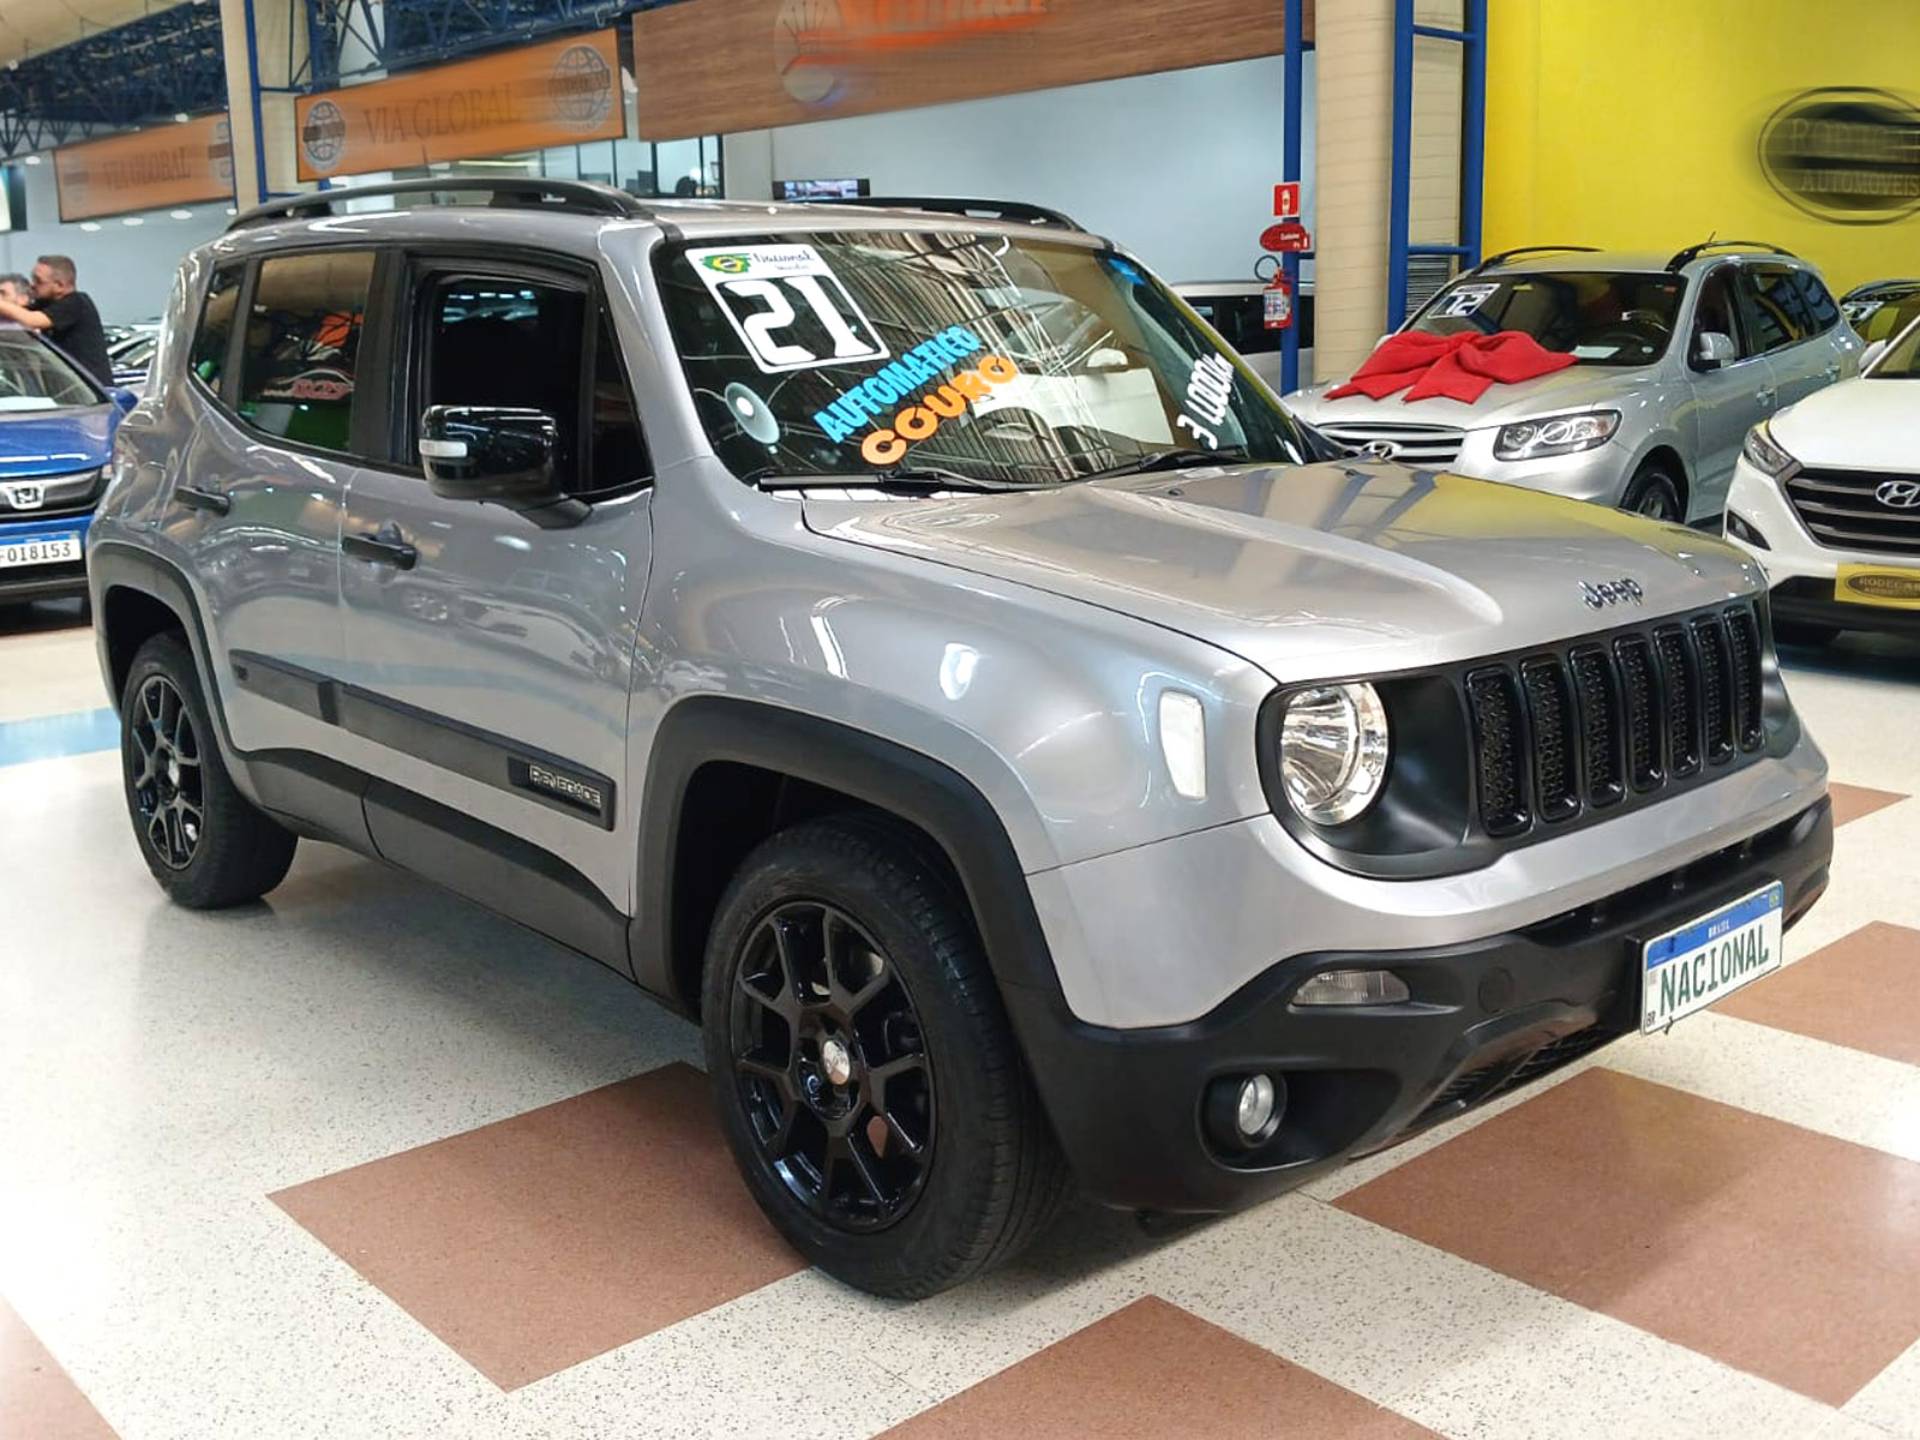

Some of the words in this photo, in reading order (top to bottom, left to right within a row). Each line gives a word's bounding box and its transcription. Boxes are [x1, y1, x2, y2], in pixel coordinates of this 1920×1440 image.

[363, 106, 409, 145] VIA
[413, 82, 521, 141] GLOBAL
[723, 275, 876, 366] 21
[861, 354, 1017, 466] COURO
[1578, 578, 1643, 611] Jeep
[1660, 924, 1770, 1017] NACIONAL
